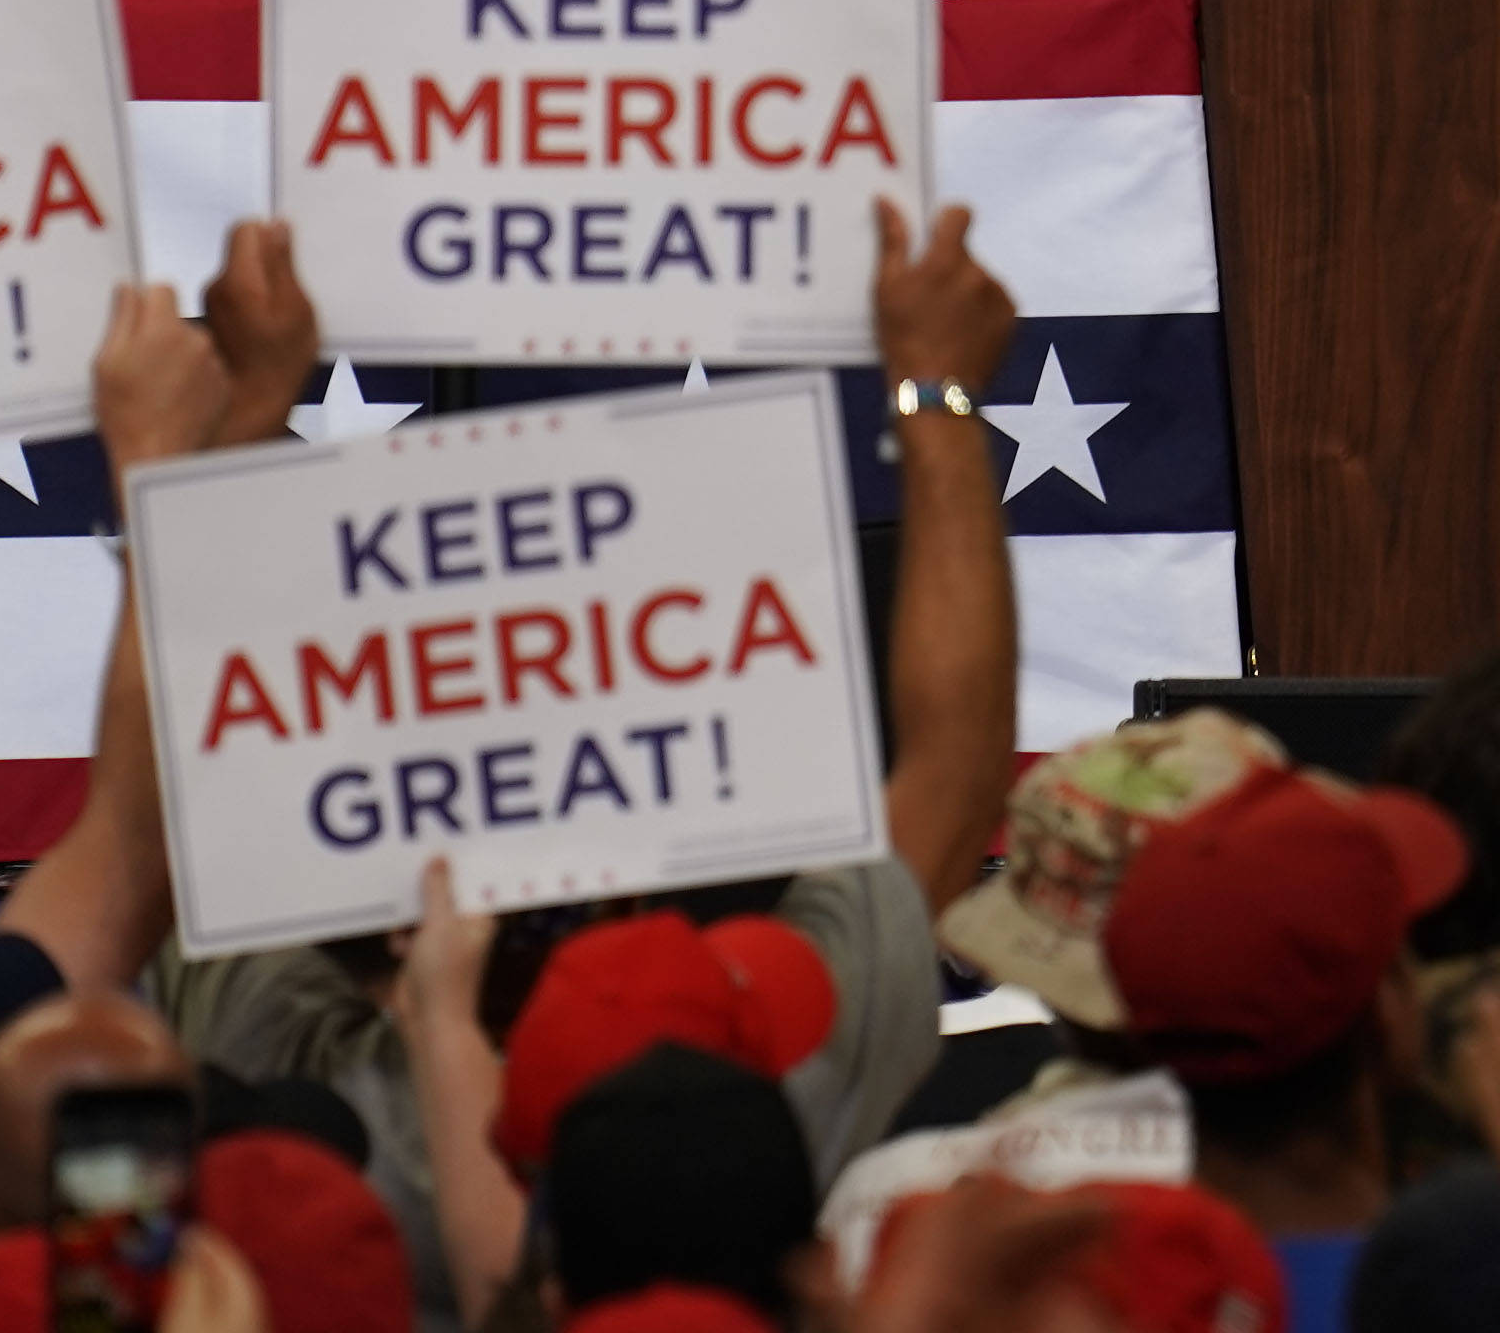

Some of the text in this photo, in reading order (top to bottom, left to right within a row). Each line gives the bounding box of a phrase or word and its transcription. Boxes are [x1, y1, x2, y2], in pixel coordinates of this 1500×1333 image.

[306, 75, 899, 169] AMERICA
[402, 203, 812, 287] GREAT!
[334, 479, 637, 599] KEEP
[200, 577, 819, 753] AMERICA
[309, 717, 737, 850] GREAT!
